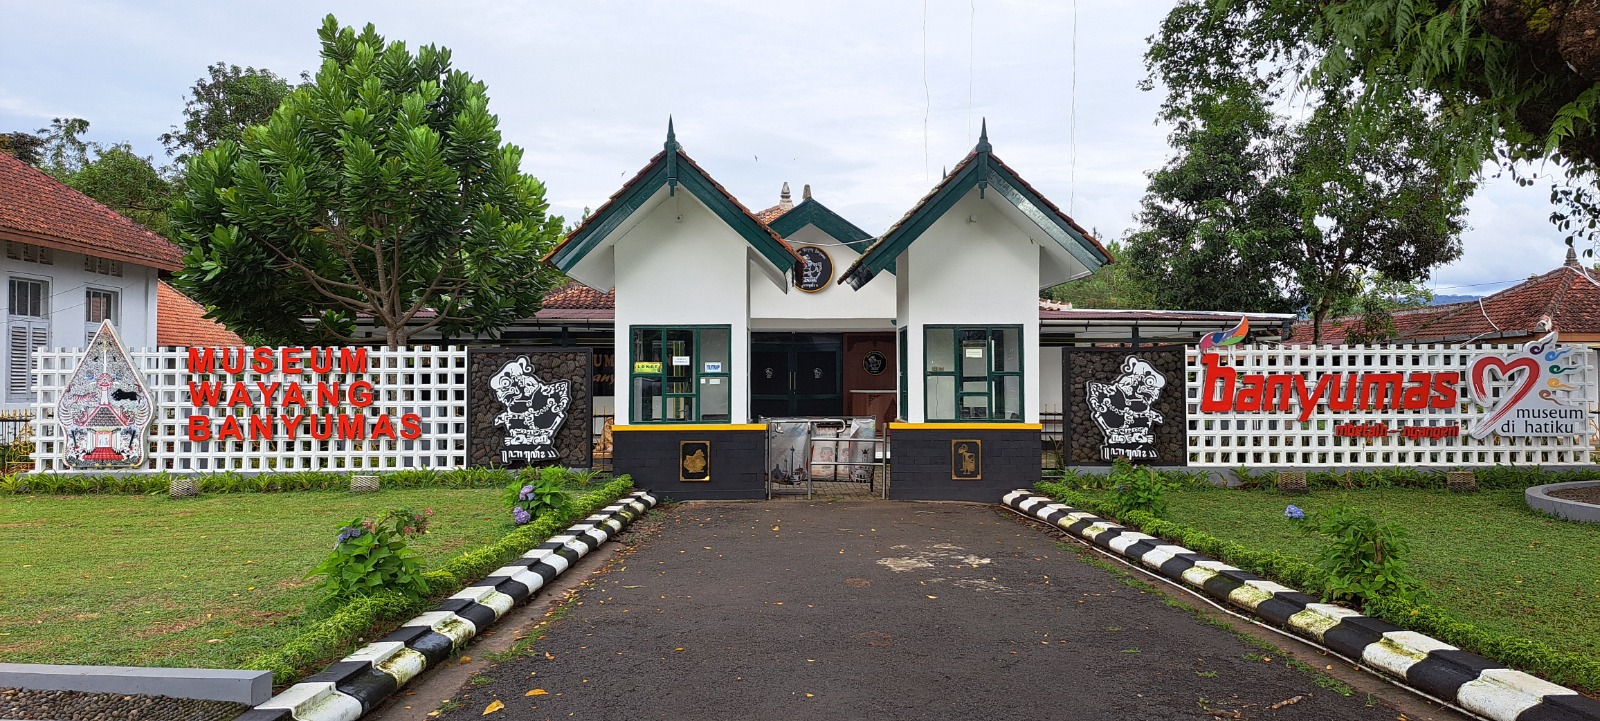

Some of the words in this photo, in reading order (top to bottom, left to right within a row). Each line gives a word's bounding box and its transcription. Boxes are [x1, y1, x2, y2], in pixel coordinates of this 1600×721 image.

[187, 347, 368, 375] MUSEUM
[188, 380, 375, 408] WAYANG
[1201, 352, 1460, 422] banyumas
[188, 413, 423, 442] BANYUMAS
[1501, 420, 1515, 433] di
[1524, 420, 1574, 434] hatiku
[1516, 408, 1584, 419] museum
[1402, 421, 1460, 441] ngangeni
